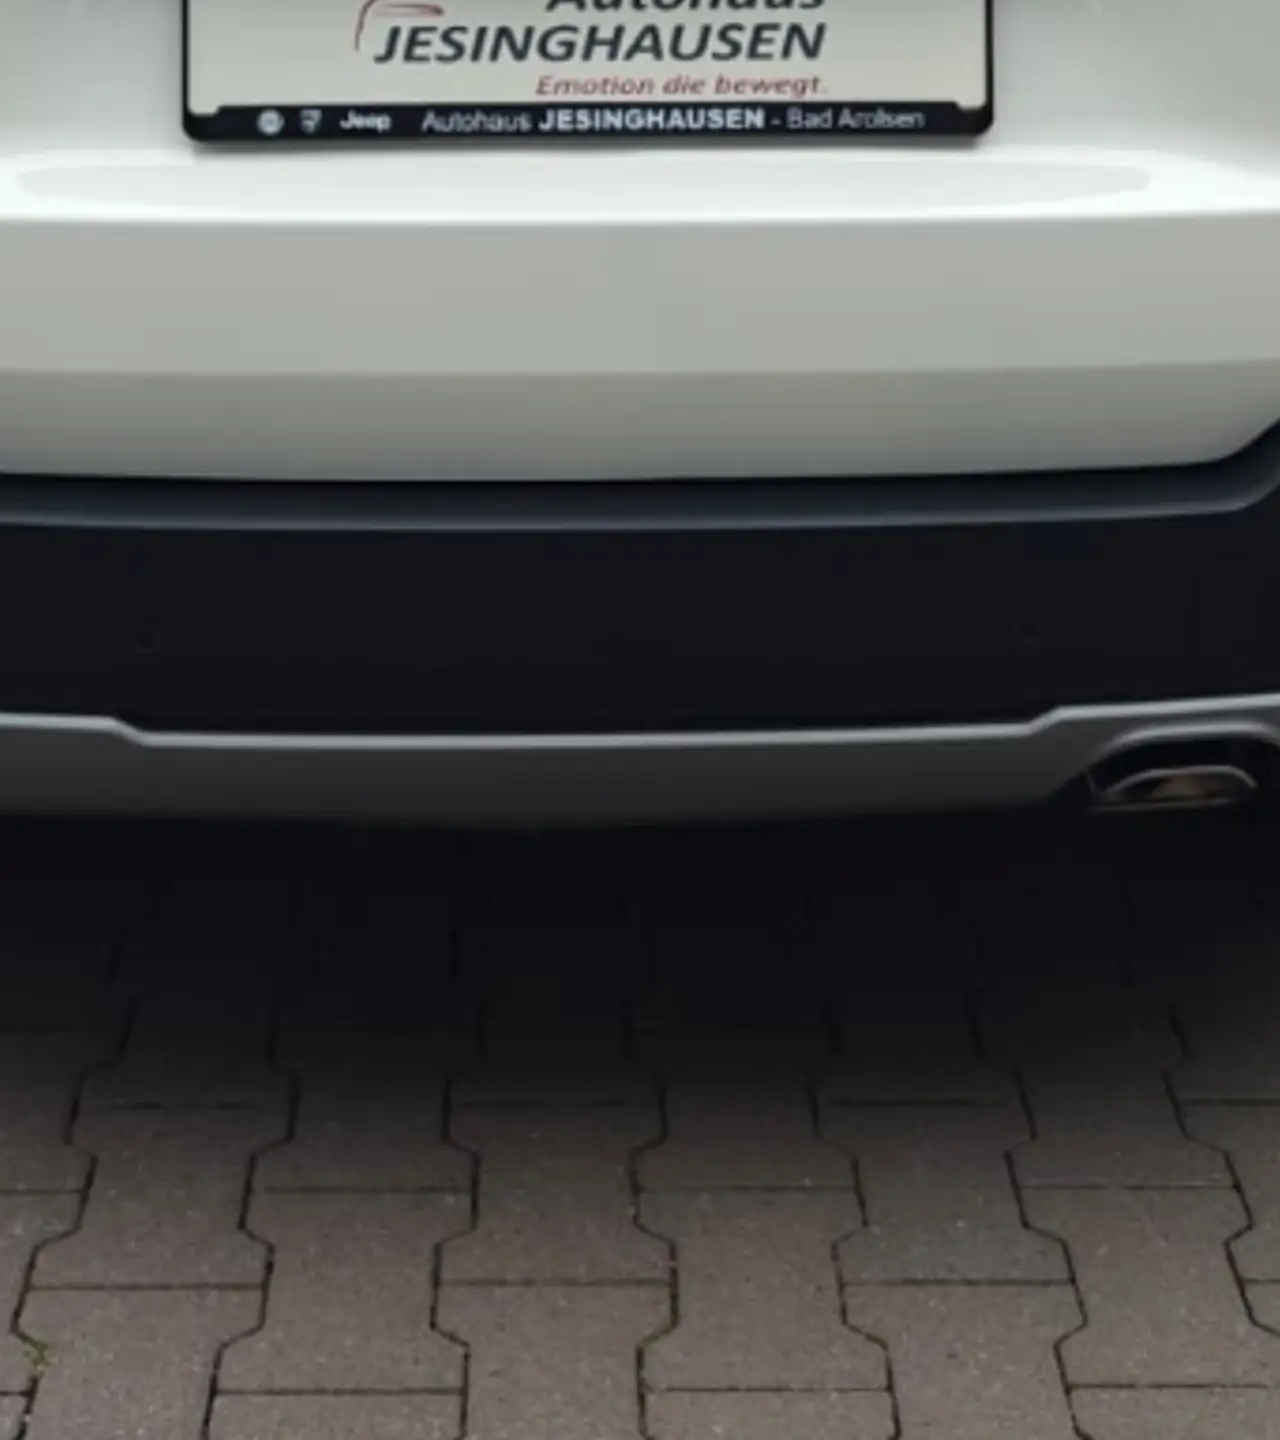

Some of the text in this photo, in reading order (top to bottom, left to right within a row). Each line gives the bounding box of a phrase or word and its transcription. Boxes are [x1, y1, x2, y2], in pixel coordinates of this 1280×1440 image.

[373, 21, 826, 65] JESINGHAUSEN
[534, 74, 828, 99] Emotion die bewegt.
[339, 112, 392, 133] Jeep
[422, 110, 532, 133] Autohaus
[538, 109, 766, 130] JESINGHAUSEN
[787, 108, 832, 129] Bad
[838, 107, 926, 129] Arolsen
